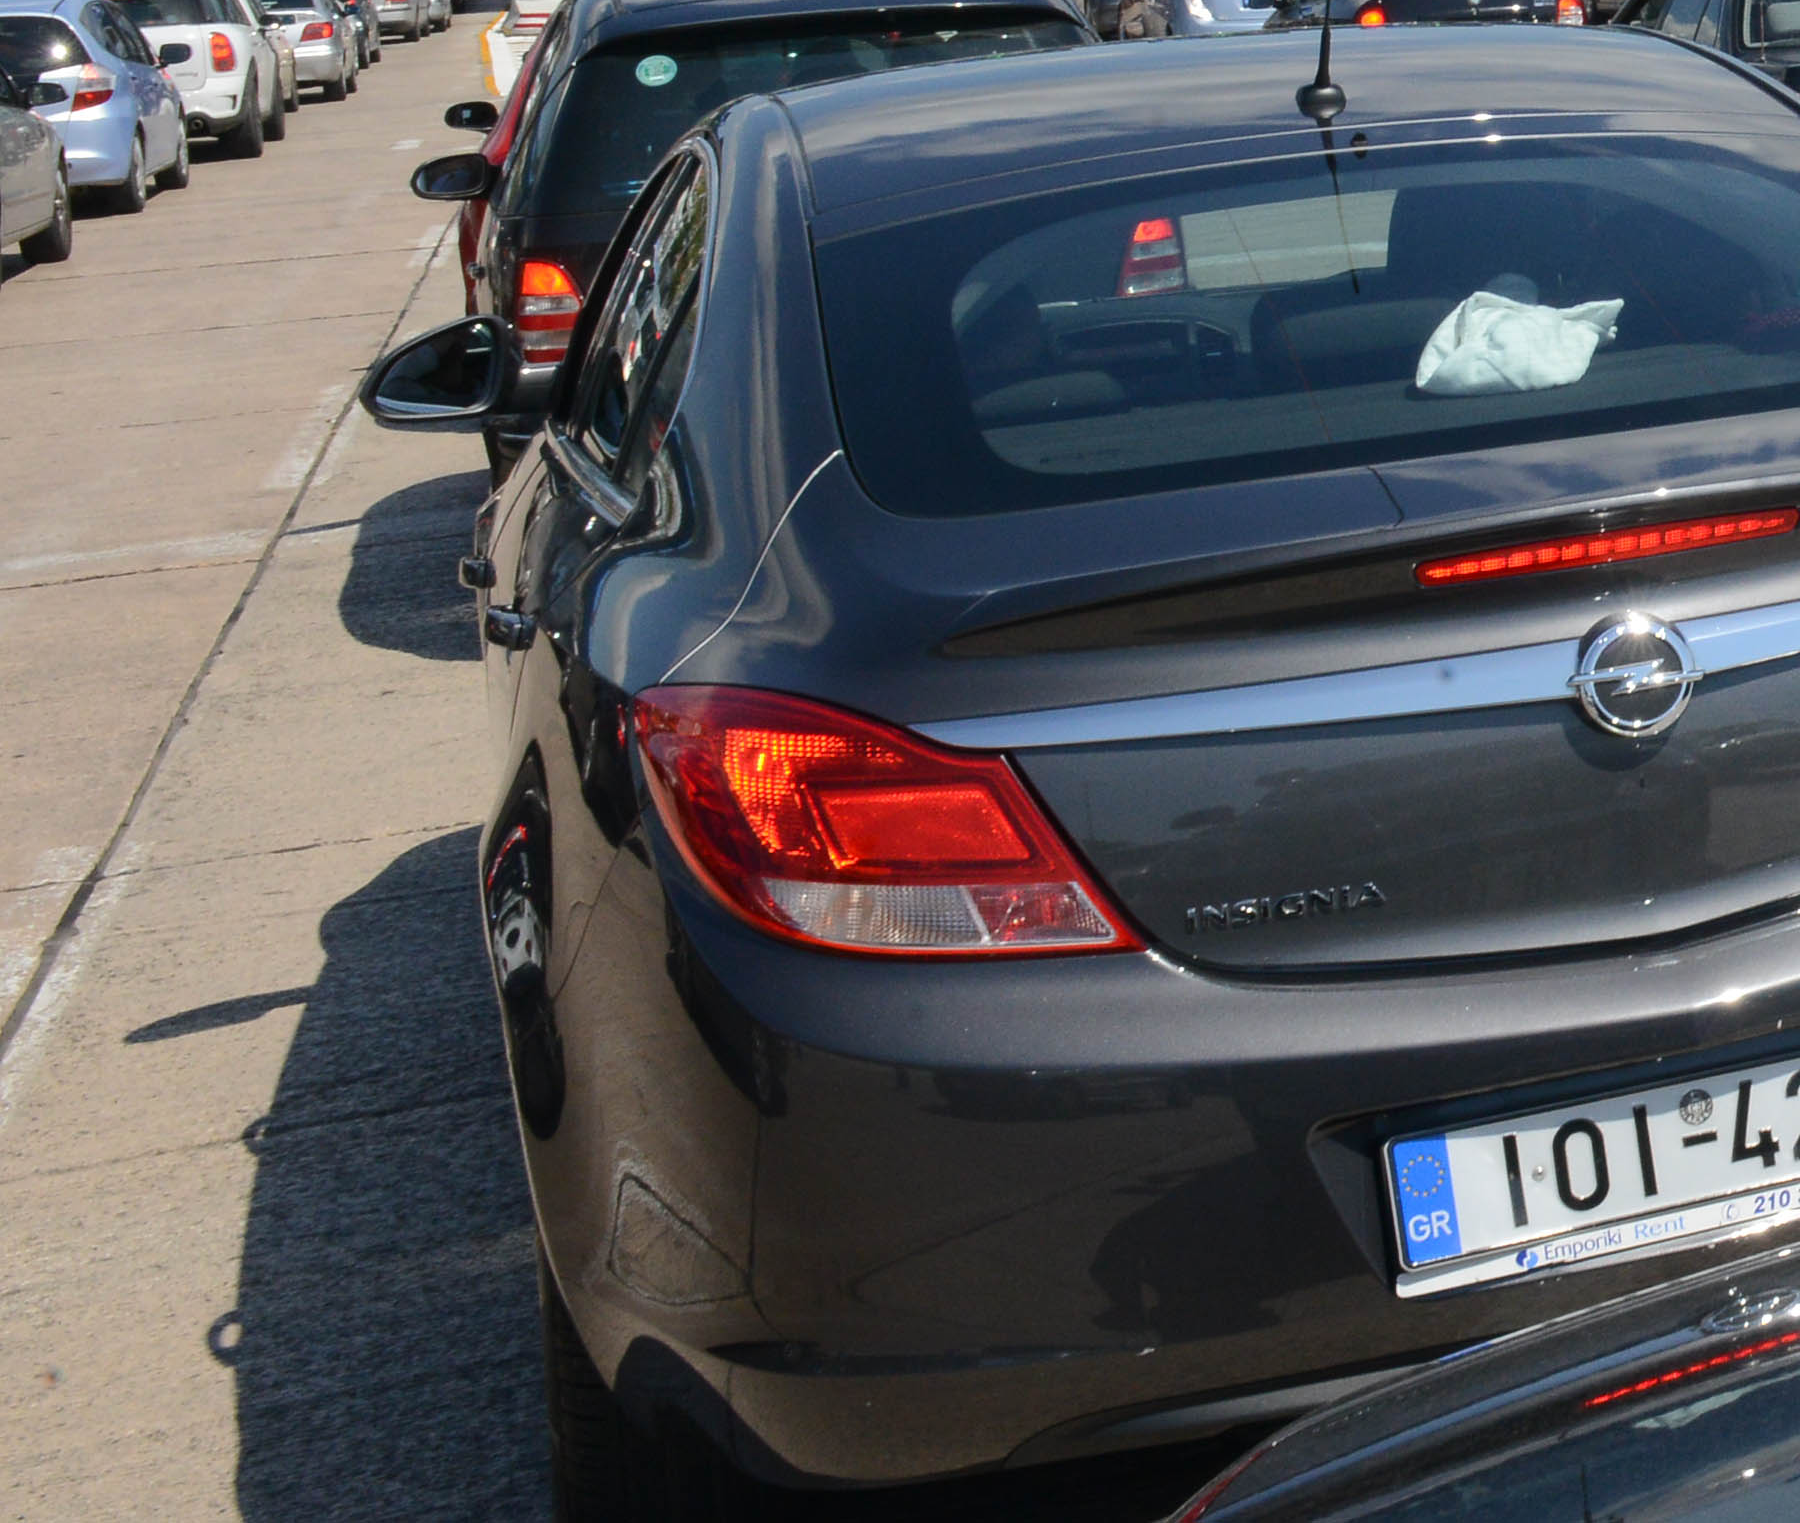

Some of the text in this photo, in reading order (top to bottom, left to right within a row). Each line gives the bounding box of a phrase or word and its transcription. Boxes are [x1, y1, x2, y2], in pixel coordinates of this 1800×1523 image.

[1186, 881, 1387, 931] INSIGNIA
[1408, 1208, 1452, 1243] GR
[1544, 1230, 1623, 1262] Emporiki
[1633, 1215, 1687, 1241] Rent
[1754, 1188, 1792, 1215] 210
